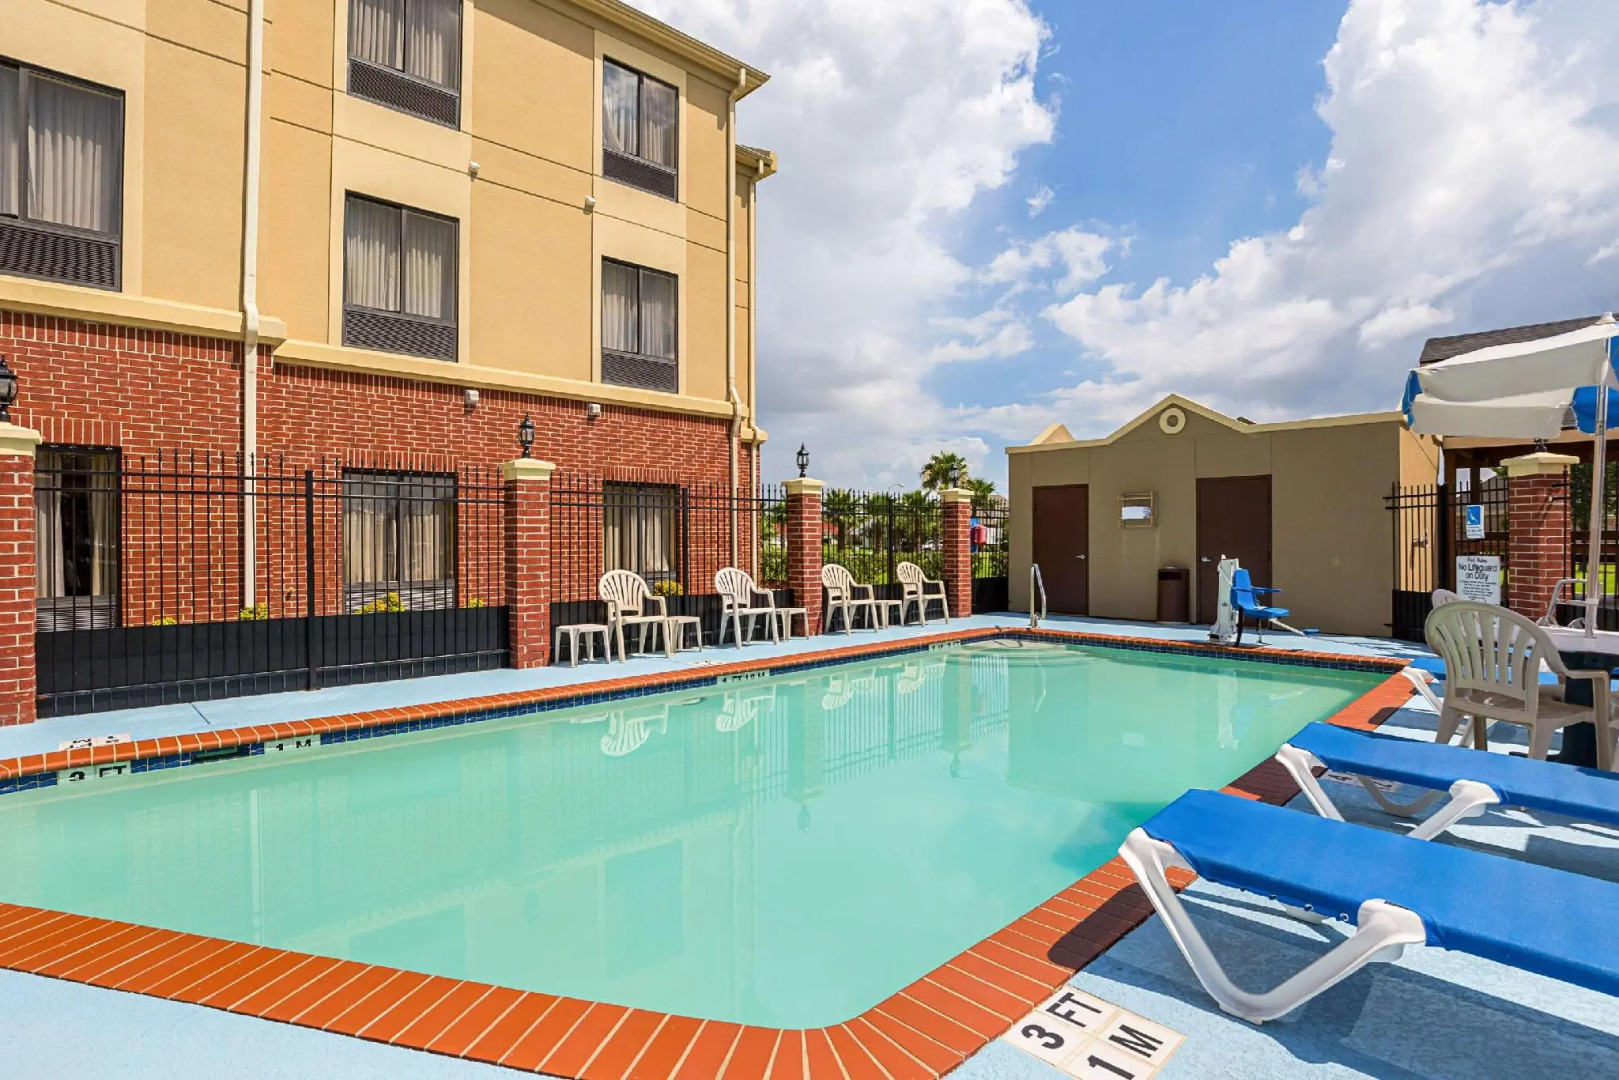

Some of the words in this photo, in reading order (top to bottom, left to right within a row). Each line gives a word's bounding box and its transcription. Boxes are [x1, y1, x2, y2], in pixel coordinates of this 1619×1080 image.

[1458, 563, 1467, 571] No
[1468, 563, 1497, 573] Lifeguard
[1475, 571, 1489, 581] Duty
[275, 742, 284, 751] 1
[296, 738, 311, 749] M
[98, 765, 127, 778] FT
[1021, 1024, 1065, 1050] 3
[1045, 991, 1103, 1028] FT
[1108, 1024, 1164, 1058] M
[1087, 1054, 1136, 1080] 1
